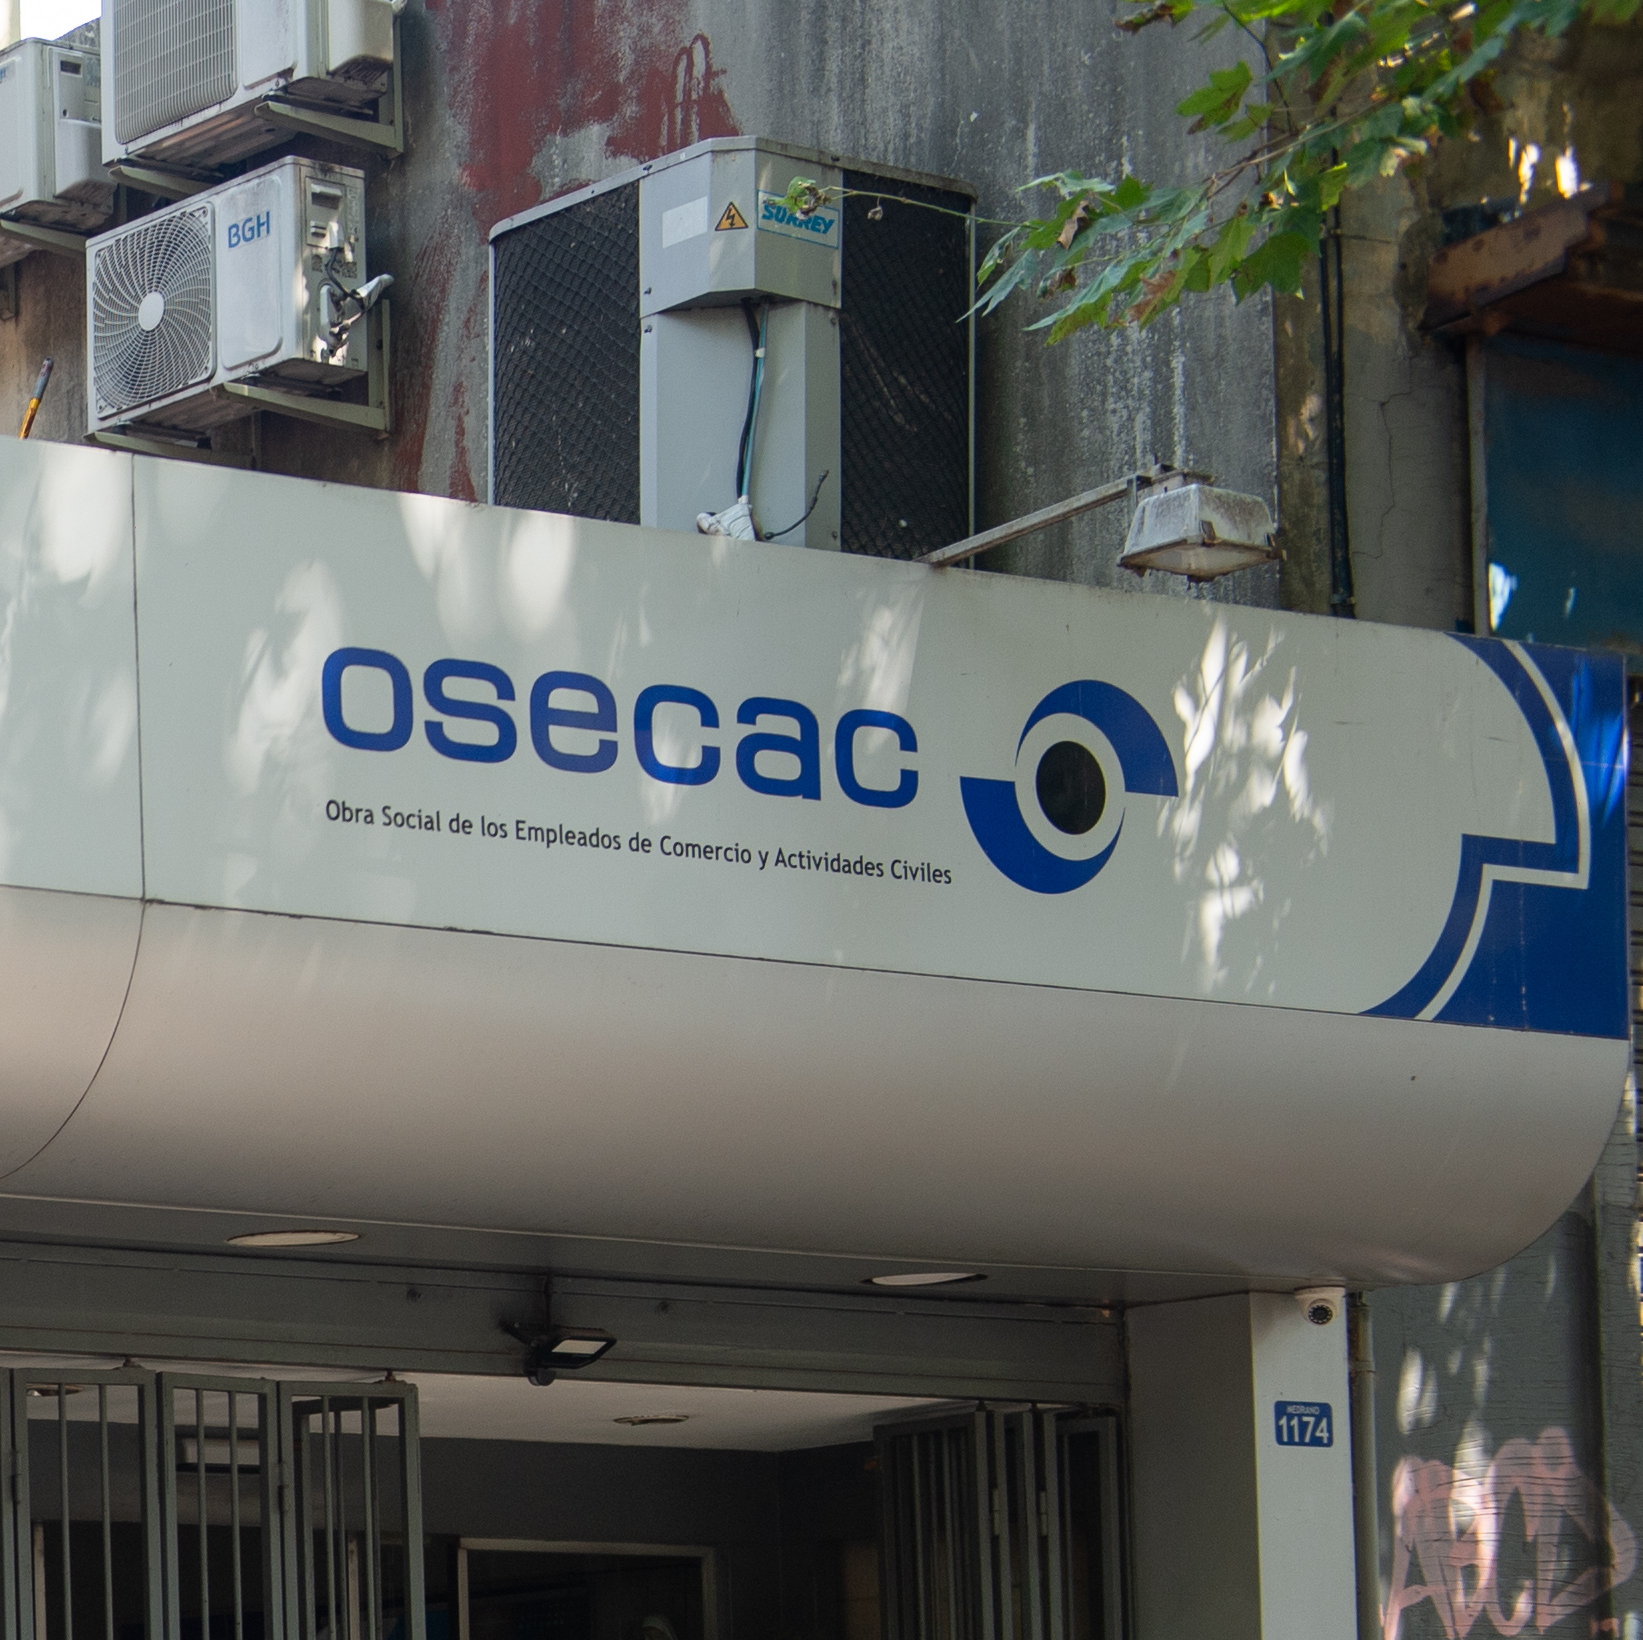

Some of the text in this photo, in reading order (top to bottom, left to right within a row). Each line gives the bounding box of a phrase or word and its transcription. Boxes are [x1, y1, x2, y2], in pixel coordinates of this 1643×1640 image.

[228, 210, 271, 249] BGH
[321, 647, 919, 809] osecac
[325, 799, 953, 885] Obra Social de los Empleados de Comercio y Actividades Civiles
[1278, 1415, 1329, 1444] 1174
